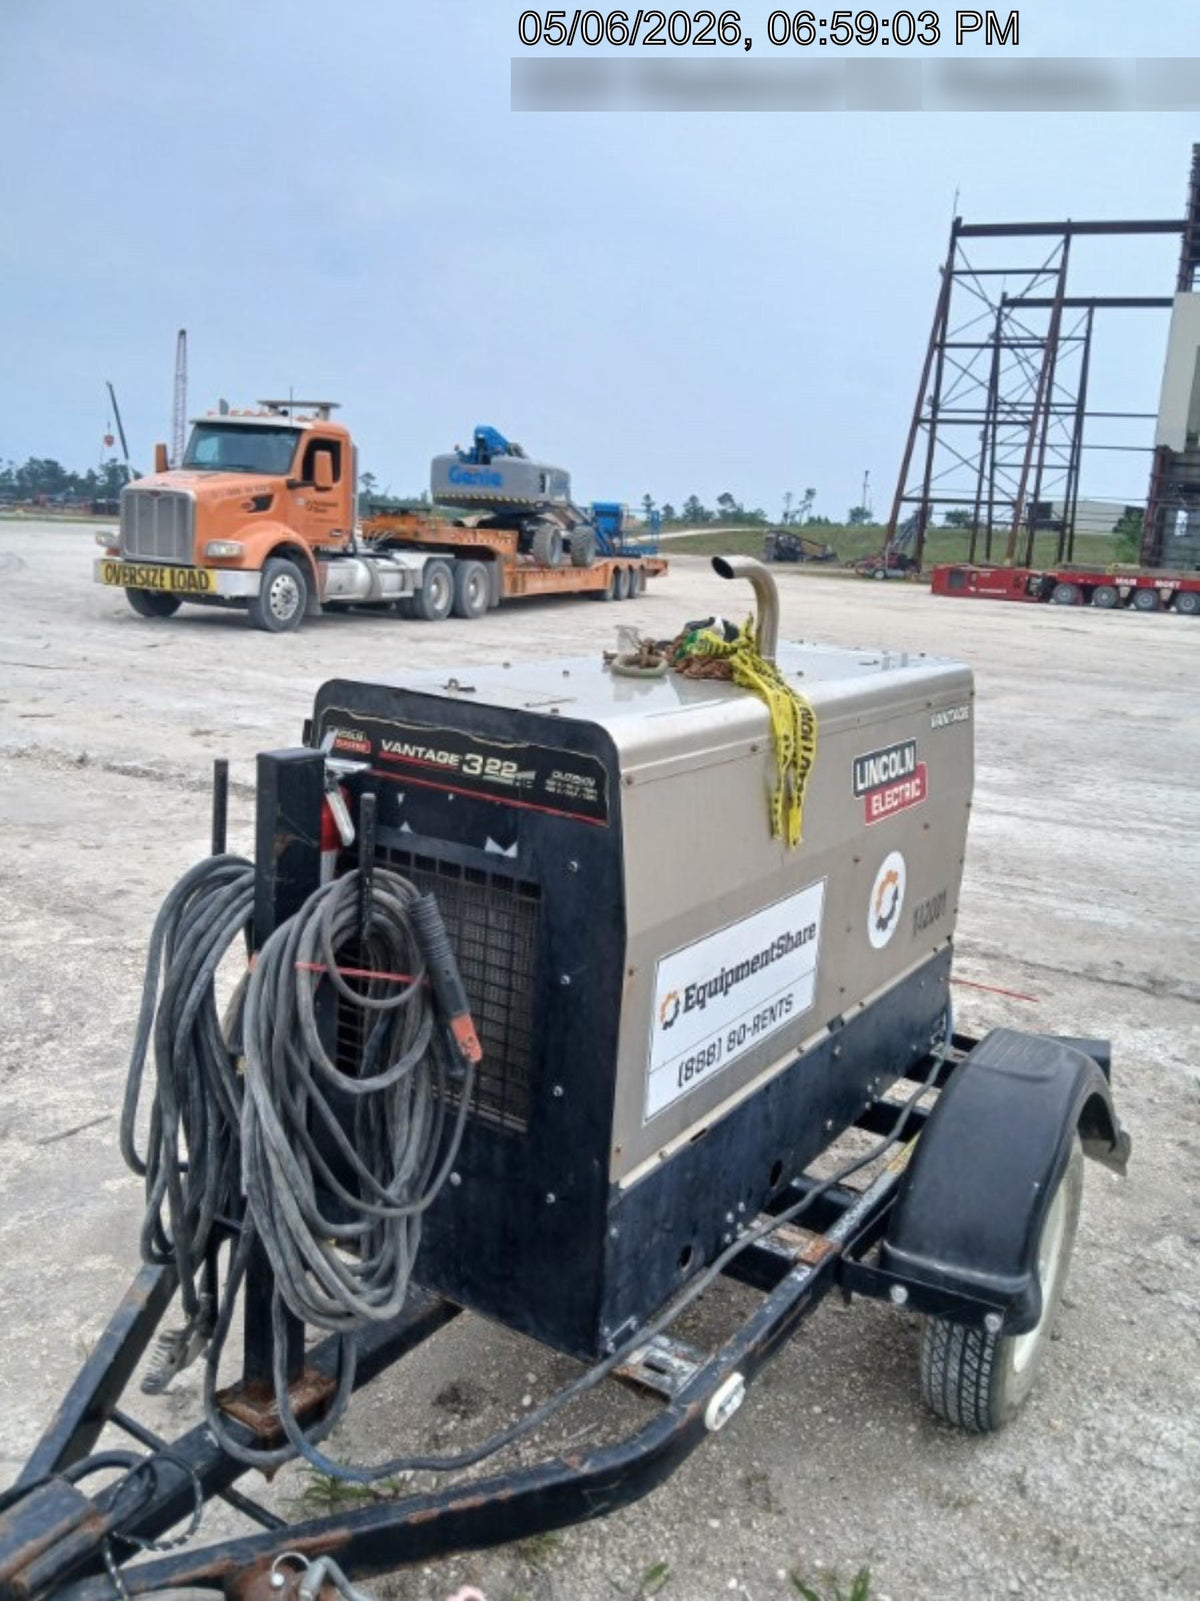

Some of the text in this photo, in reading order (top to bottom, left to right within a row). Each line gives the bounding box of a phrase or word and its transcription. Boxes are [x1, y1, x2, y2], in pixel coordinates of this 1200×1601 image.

[448, 464, 502, 488] Genie
[105, 563, 209, 590] OVERSIZE LOAD
[381, 738, 460, 767] VANTAGE
[462, 753, 518, 776] 322
[856, 745, 915, 791] LINCOLN
[871, 777, 921, 815] ELECTRIC
[682, 922, 817, 1013] EquipmentShare
[678, 993, 794, 1088] (888) 80-RENTS
